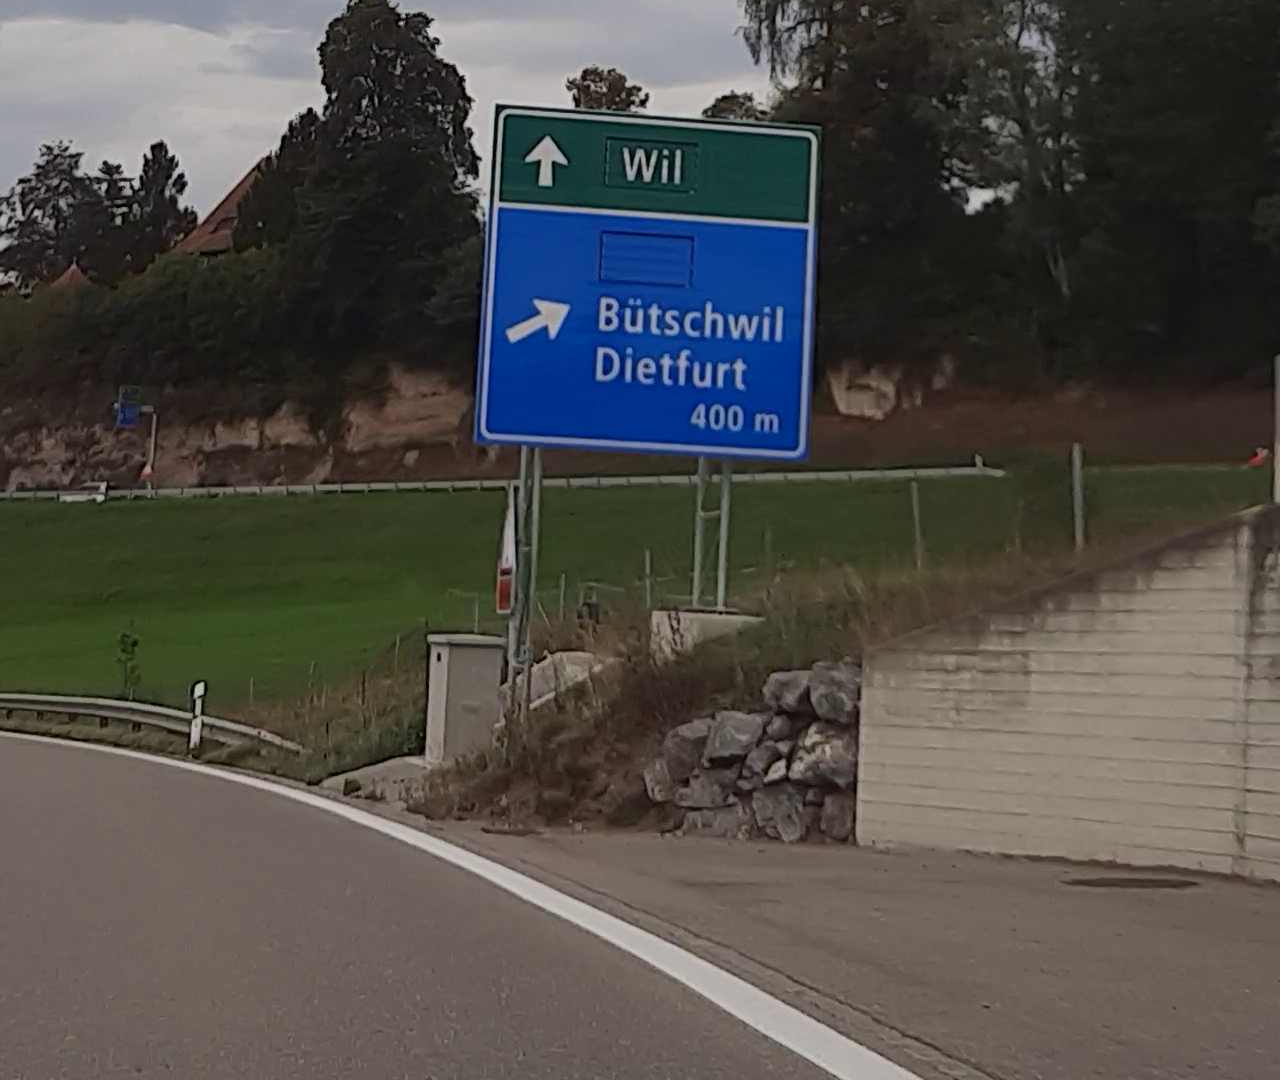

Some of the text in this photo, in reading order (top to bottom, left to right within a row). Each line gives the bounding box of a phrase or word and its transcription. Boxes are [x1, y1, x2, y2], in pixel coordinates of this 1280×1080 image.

[622, 147, 683, 186] Wil
[598, 296, 784, 343] Bütschwil
[595, 346, 747, 391] Dietfurt
[690, 403, 780, 434] 400 m
